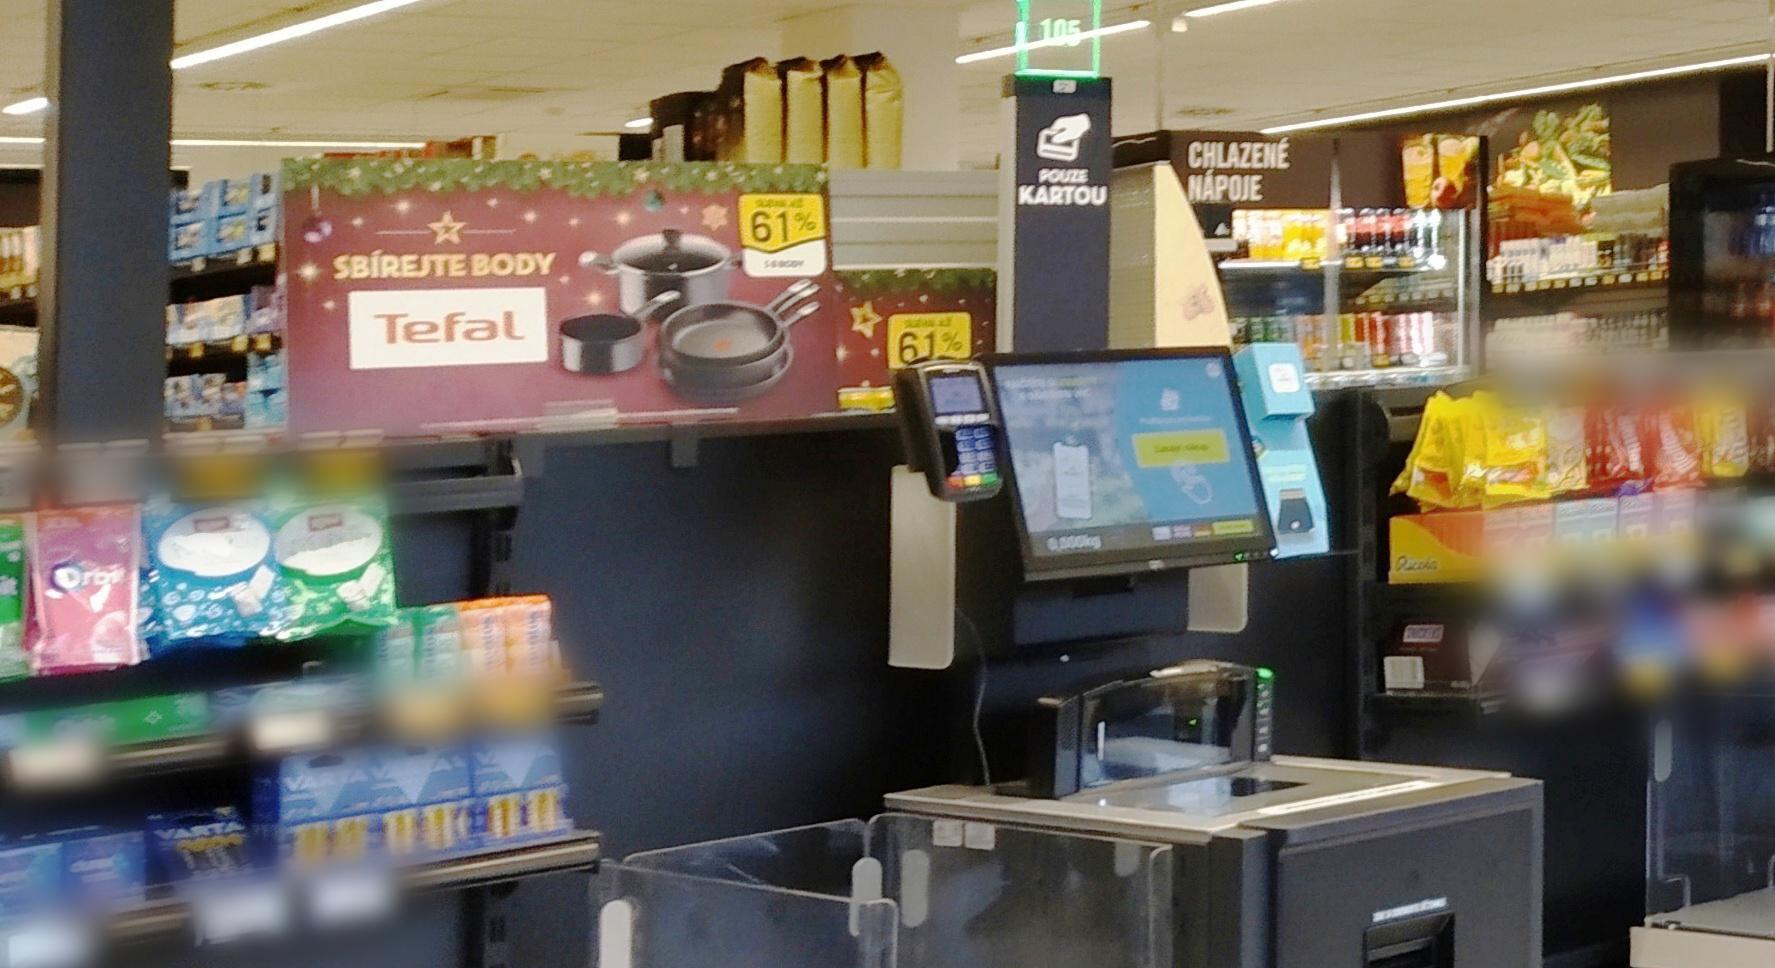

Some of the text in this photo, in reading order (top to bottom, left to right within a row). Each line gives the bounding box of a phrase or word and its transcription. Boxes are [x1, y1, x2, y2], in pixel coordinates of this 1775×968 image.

[1041, 18, 1081, 47] 105
[1187, 137, 1290, 170] CHLAZENÉ
[1038, 168, 1089, 183] POUZE
[1187, 168, 1263, 202] NÁPOJE
[1018, 185, 1108, 206] KARTOU
[333, 249, 556, 280] SBÍREJTE BODY
[373, 310, 526, 345] Tefal
